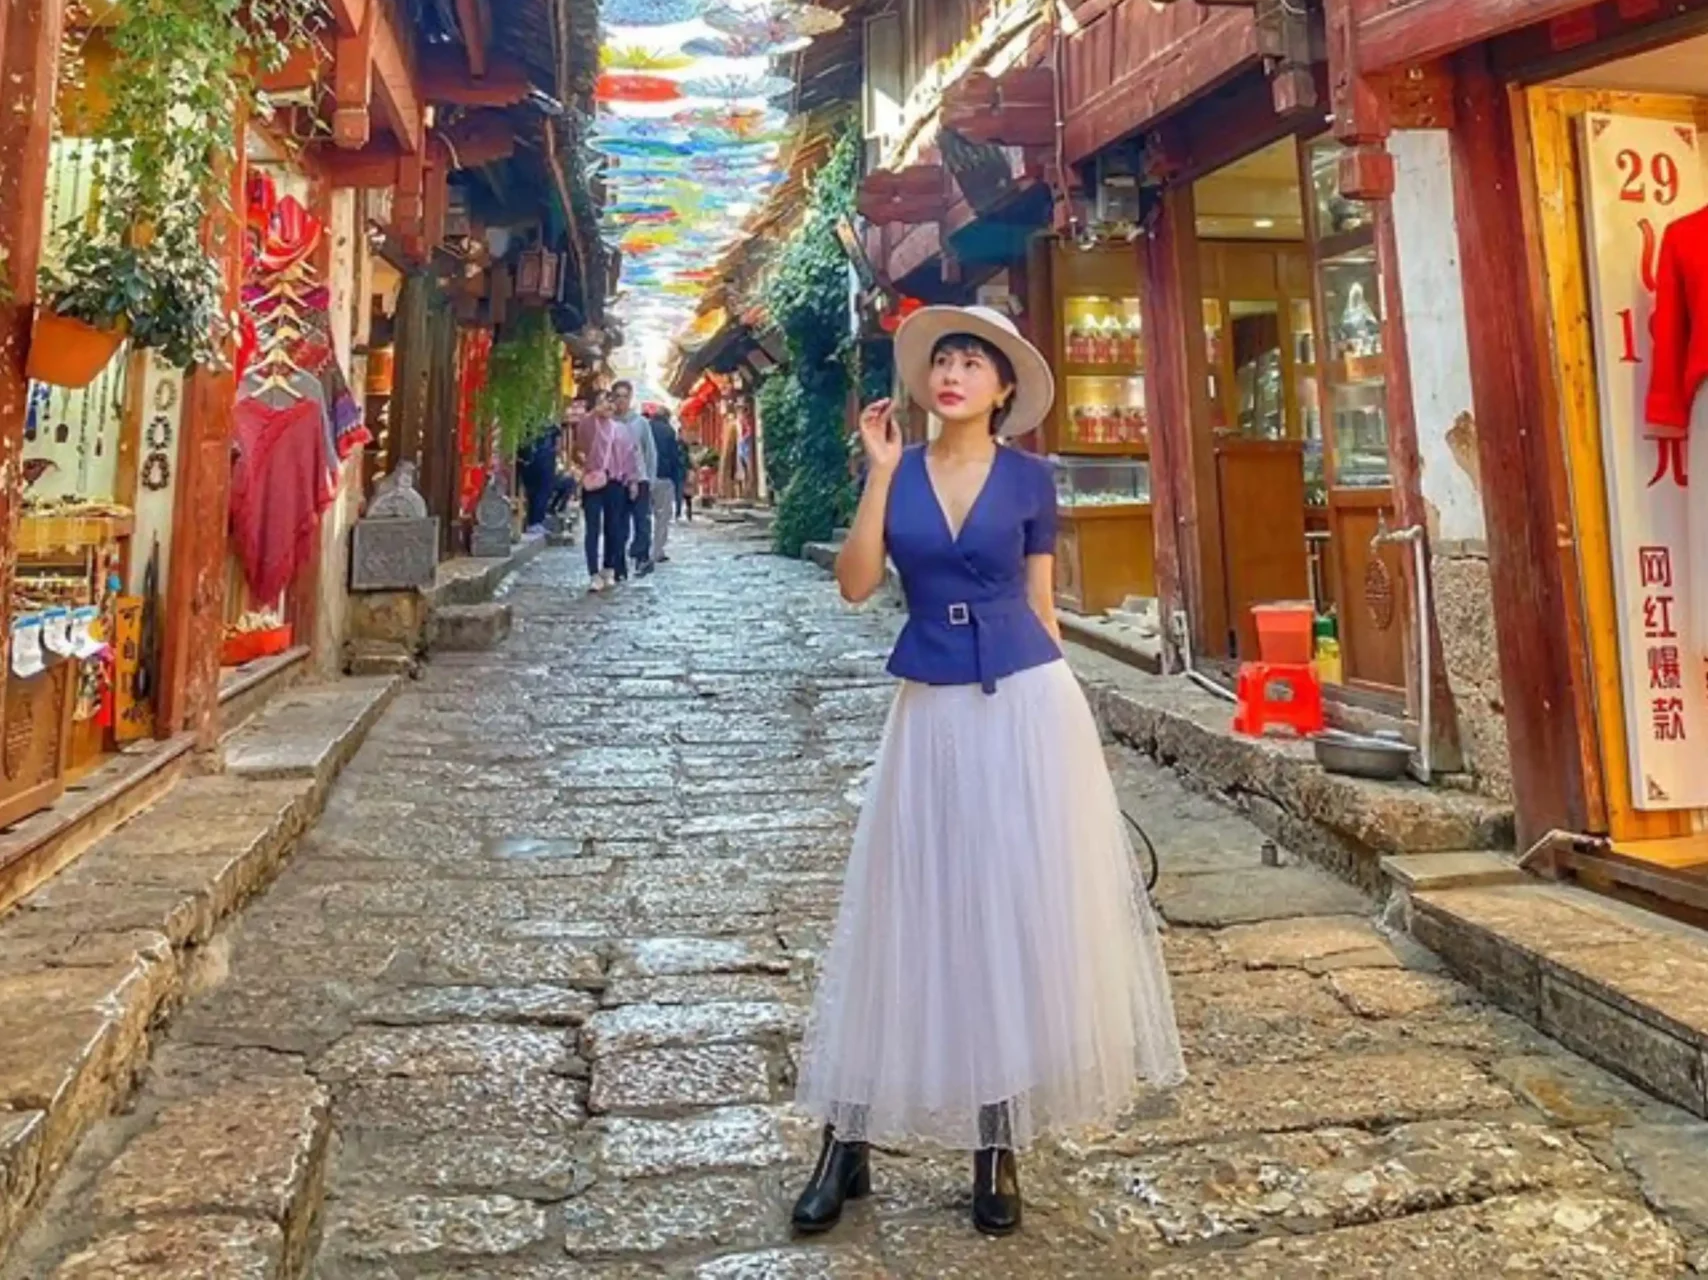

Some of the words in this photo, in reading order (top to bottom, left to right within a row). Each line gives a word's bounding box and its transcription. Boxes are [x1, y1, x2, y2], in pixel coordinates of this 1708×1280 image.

[1616, 149, 1679, 206] 29
[1638, 545, 1686, 740] 网红爆款
